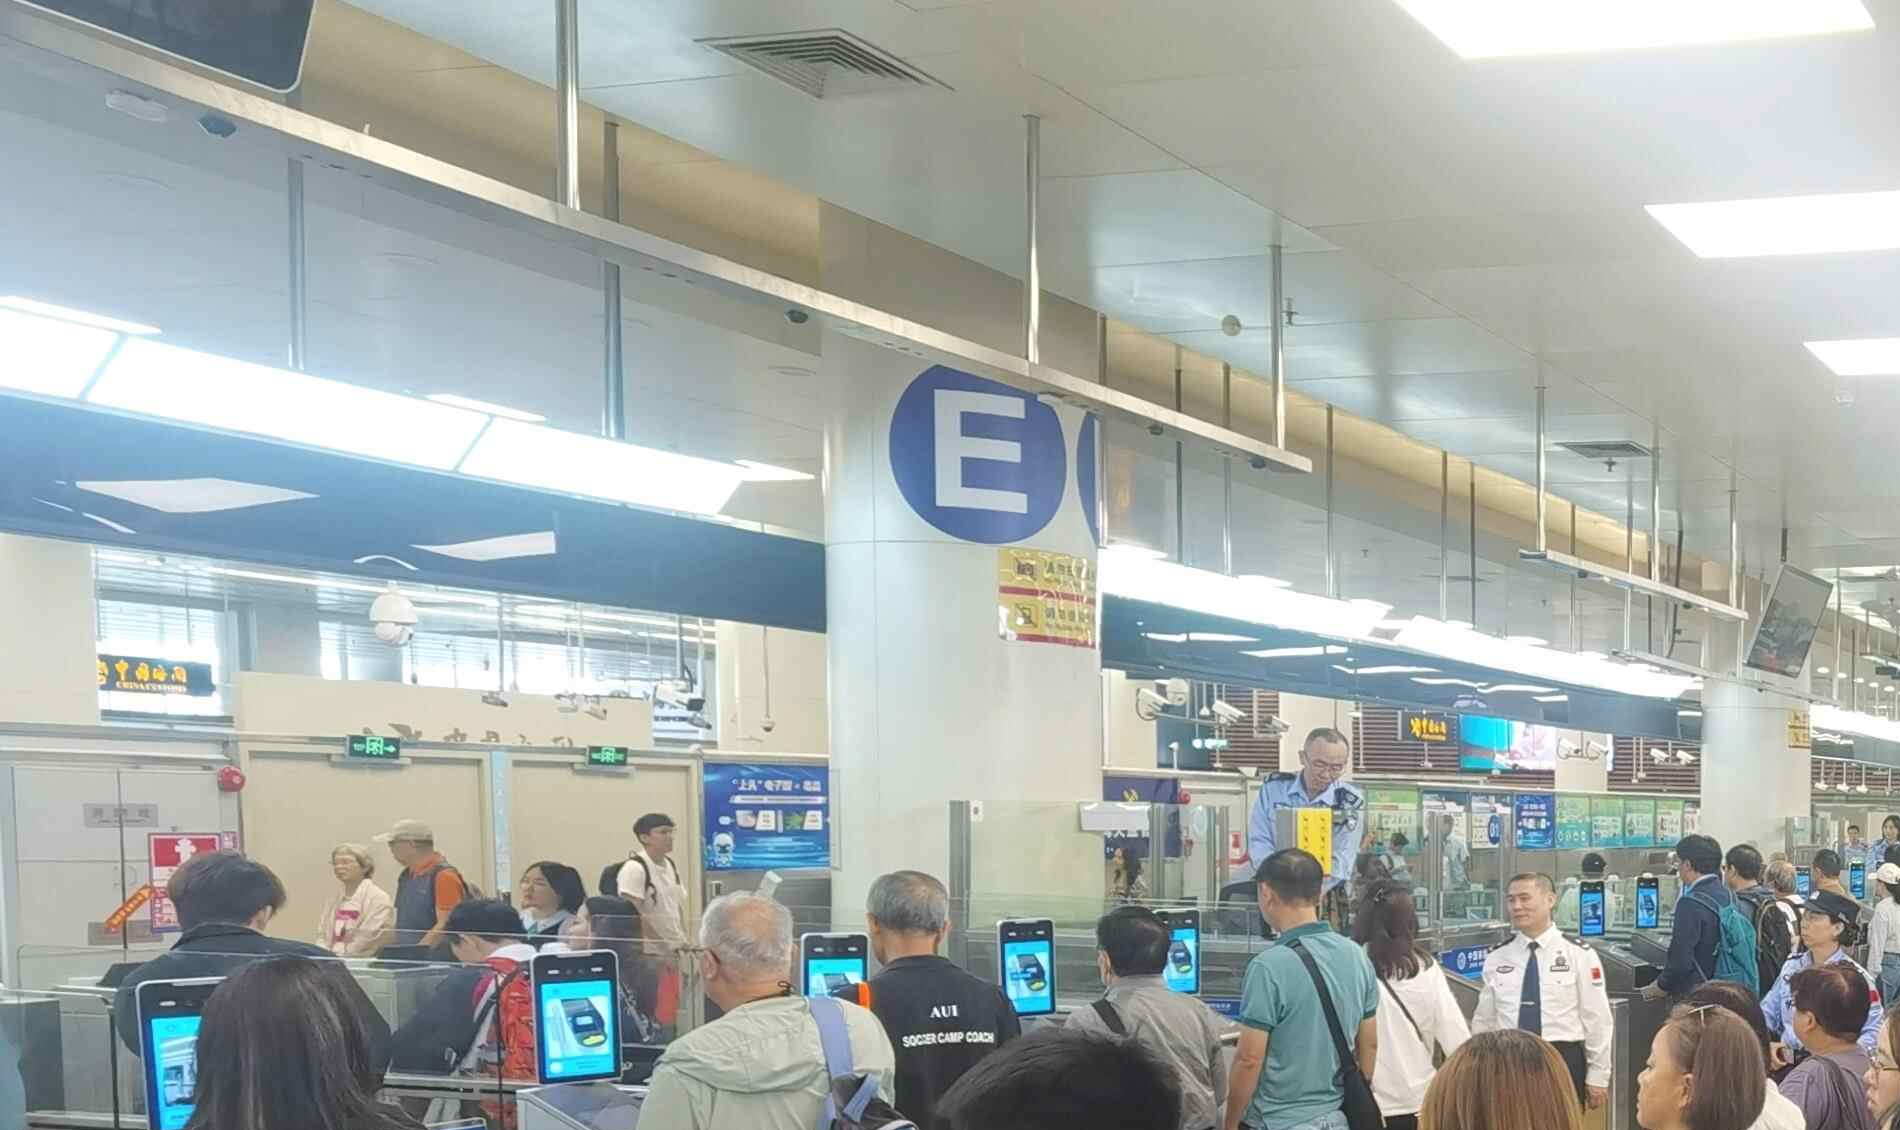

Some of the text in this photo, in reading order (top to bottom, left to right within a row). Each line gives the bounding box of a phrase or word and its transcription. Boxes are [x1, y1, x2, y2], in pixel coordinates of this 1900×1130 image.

[934, 389, 1028, 514] E
[929, 1004, 958, 1018] AUI
[937, 1031, 964, 1044] CAMP
[966, 1031, 995, 1043] COACH
